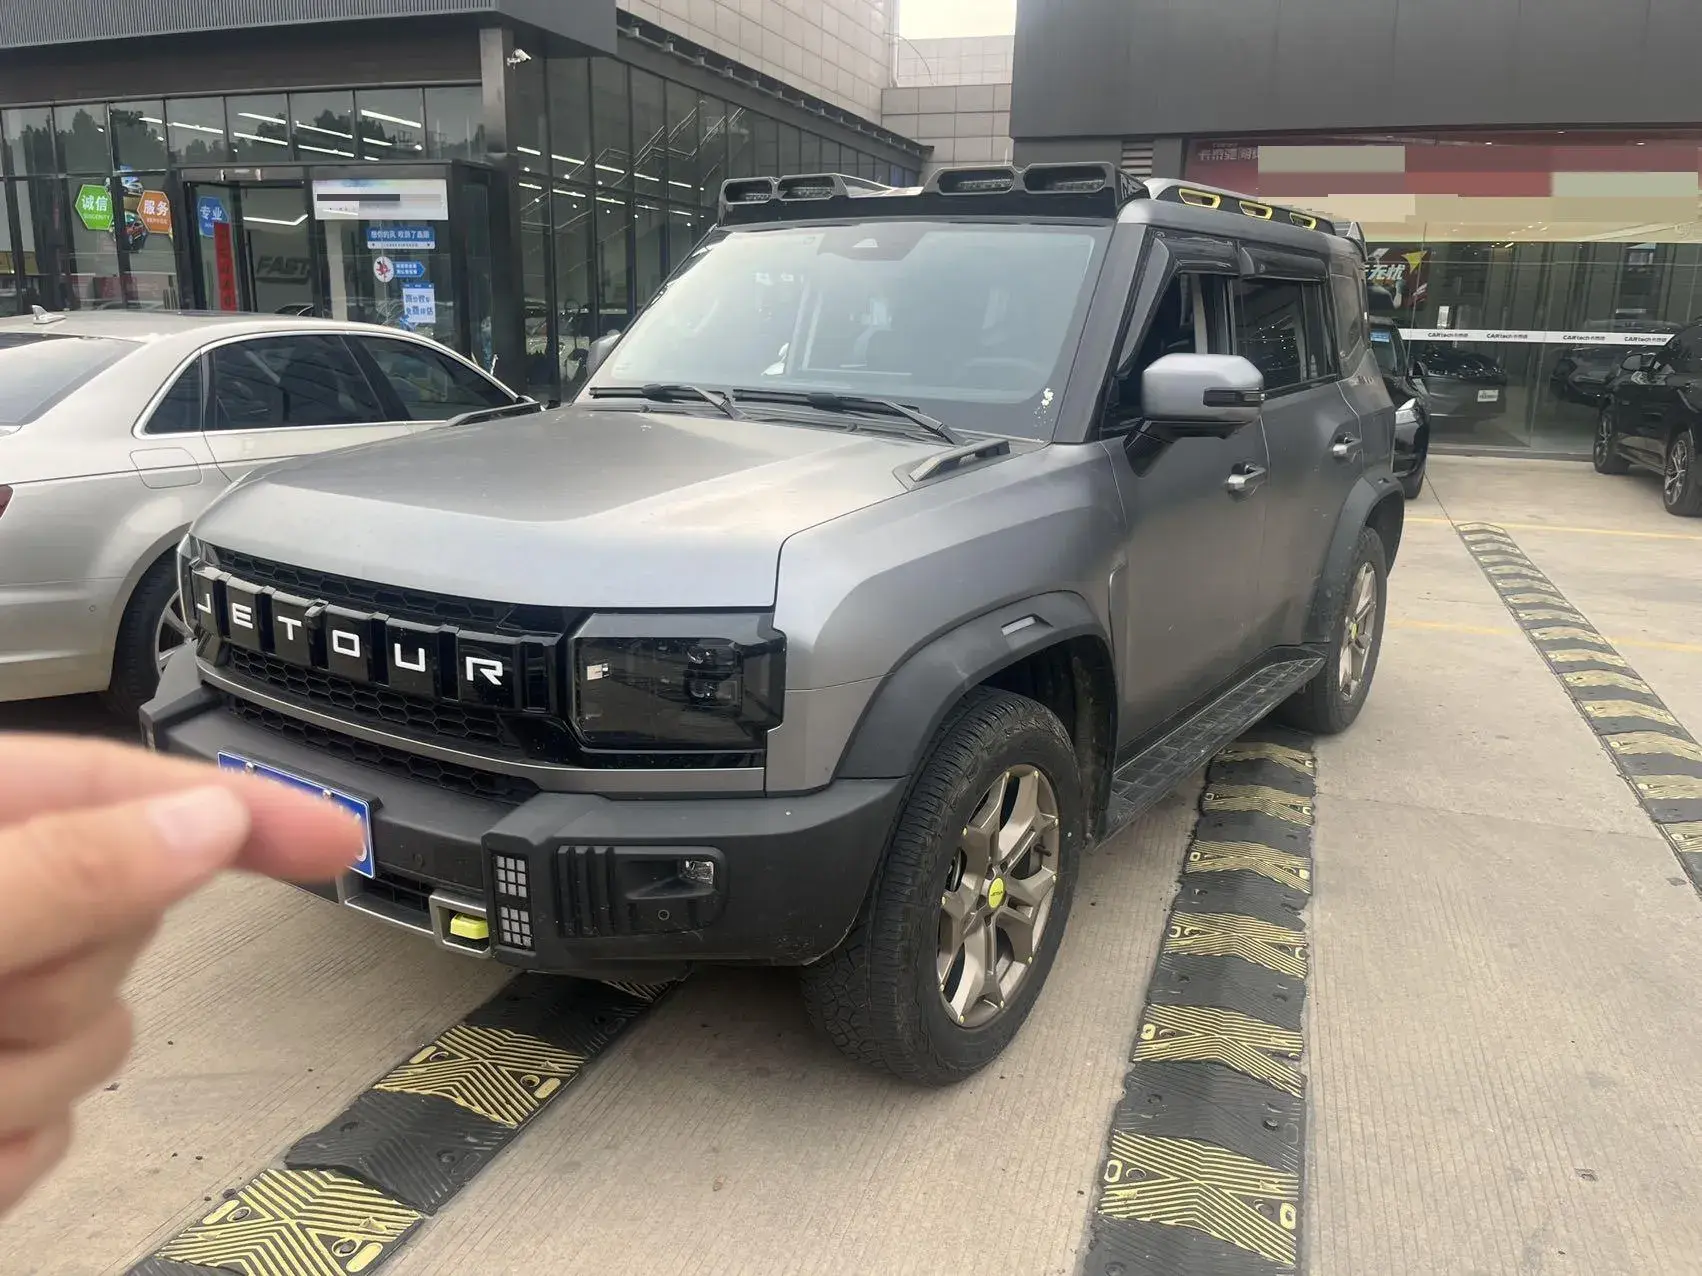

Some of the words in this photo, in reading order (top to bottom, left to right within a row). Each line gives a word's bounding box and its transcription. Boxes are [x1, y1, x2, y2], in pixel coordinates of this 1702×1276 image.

[81, 194, 108, 212] 诚信
[143, 199, 169, 217] 服务
[199, 205, 223, 221] 专业
[1364, 264, 1406, 280] 无忧
[197, 593, 503, 685] JETOUR
